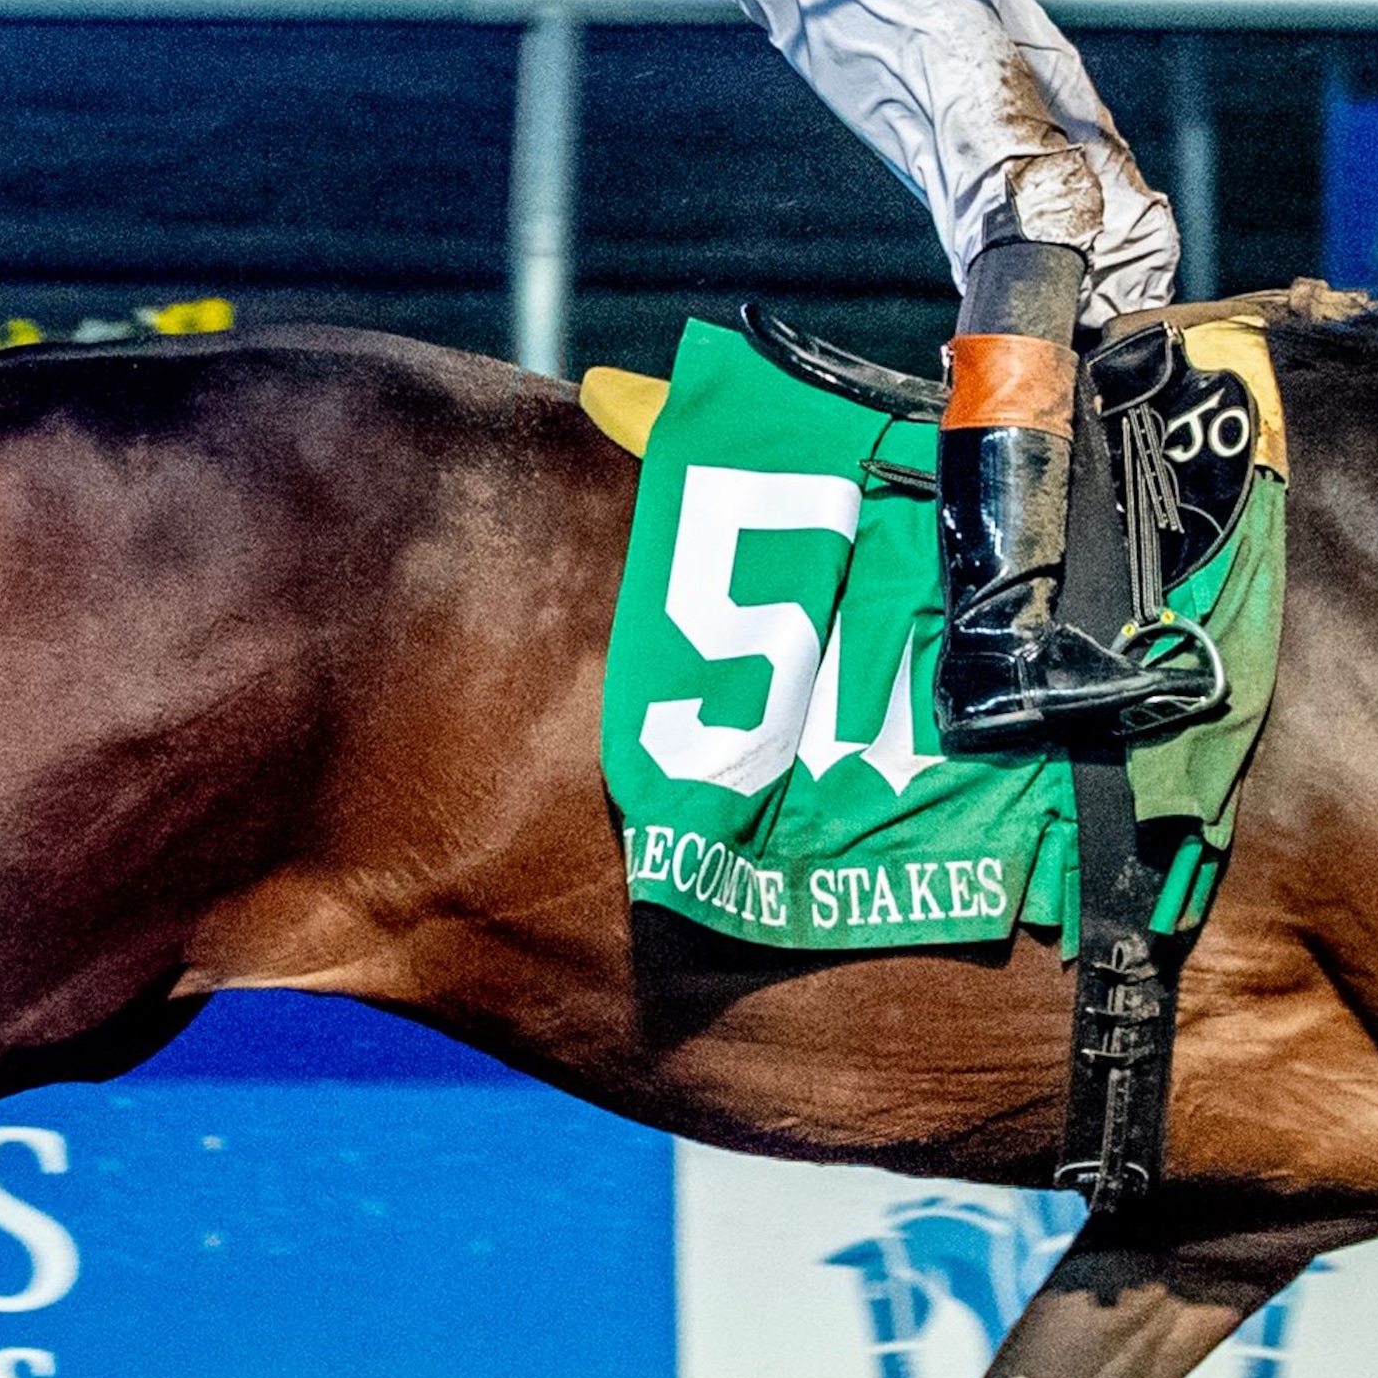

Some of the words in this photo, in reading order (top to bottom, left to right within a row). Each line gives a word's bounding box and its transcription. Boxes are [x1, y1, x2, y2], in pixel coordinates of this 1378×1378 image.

[1163, 387, 1250, 458] JO
[638, 464, 863, 798] 5
[810, 857, 1008, 929] STAKES
